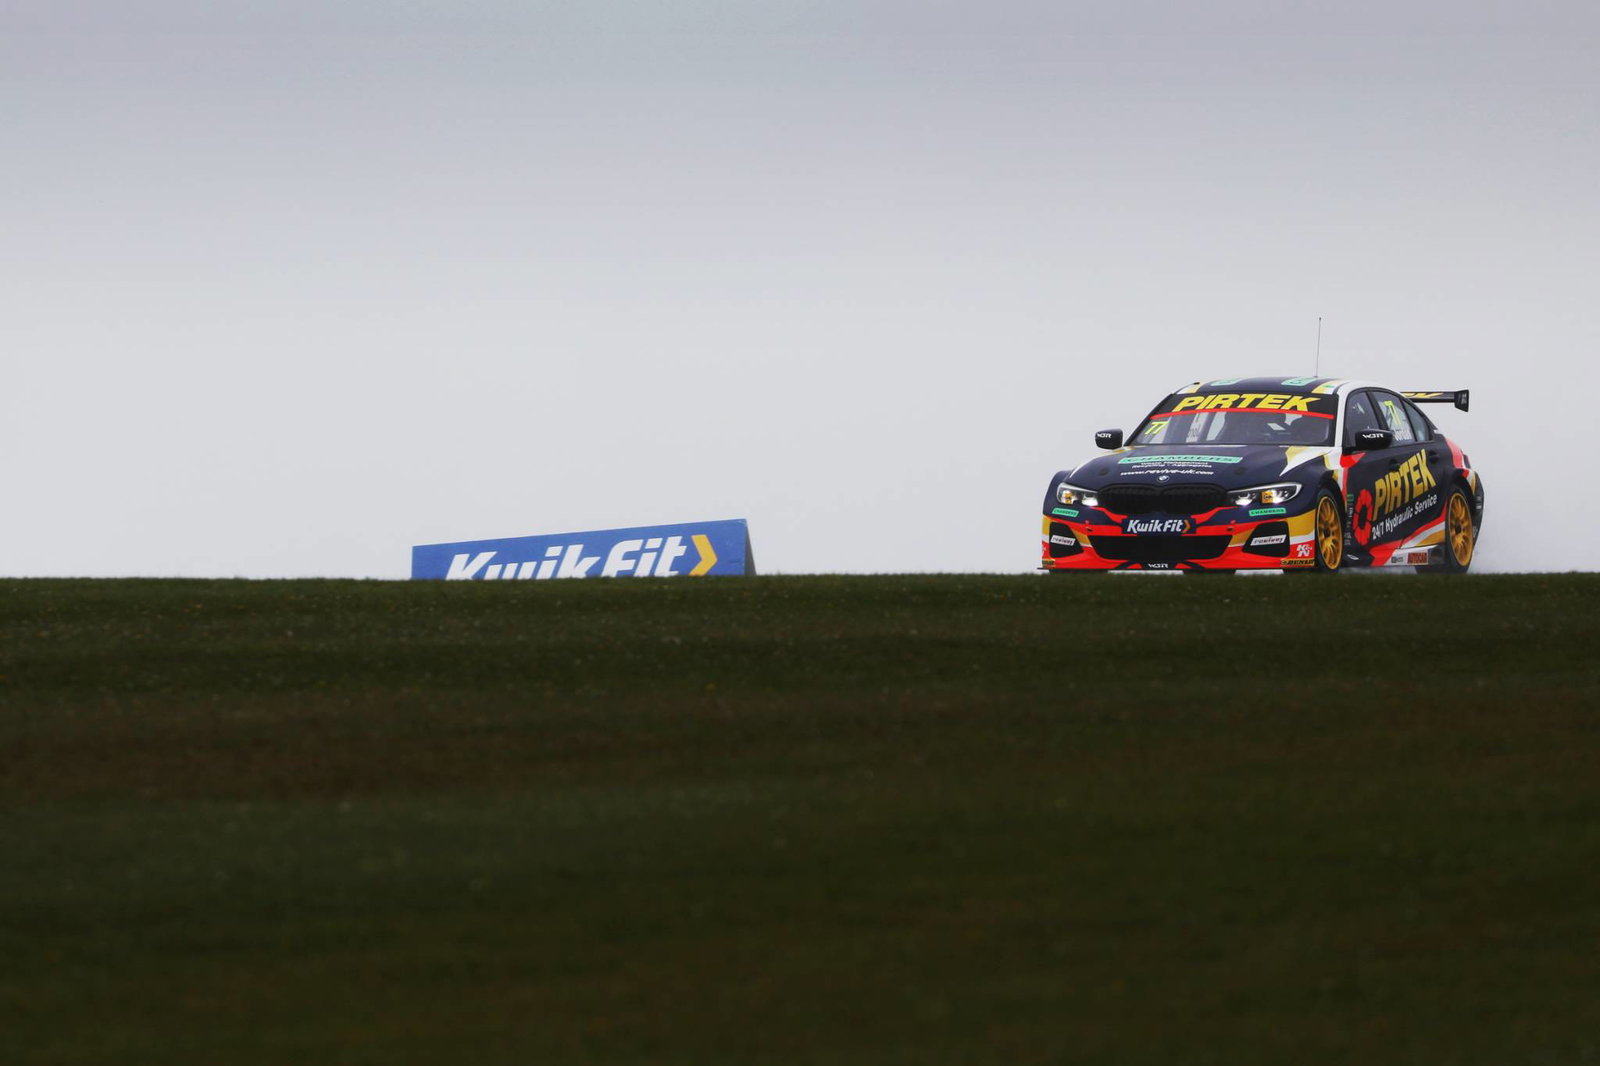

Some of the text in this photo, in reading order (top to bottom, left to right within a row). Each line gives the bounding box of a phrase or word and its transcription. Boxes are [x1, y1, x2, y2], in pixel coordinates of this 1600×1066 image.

[1171, 393, 1321, 412] PIRTEK
[1144, 421, 1169, 435] 77
[1372, 449, 1437, 522] PIRTEK
[1371, 494, 1437, 541] 24/7 Hydraulic Service
